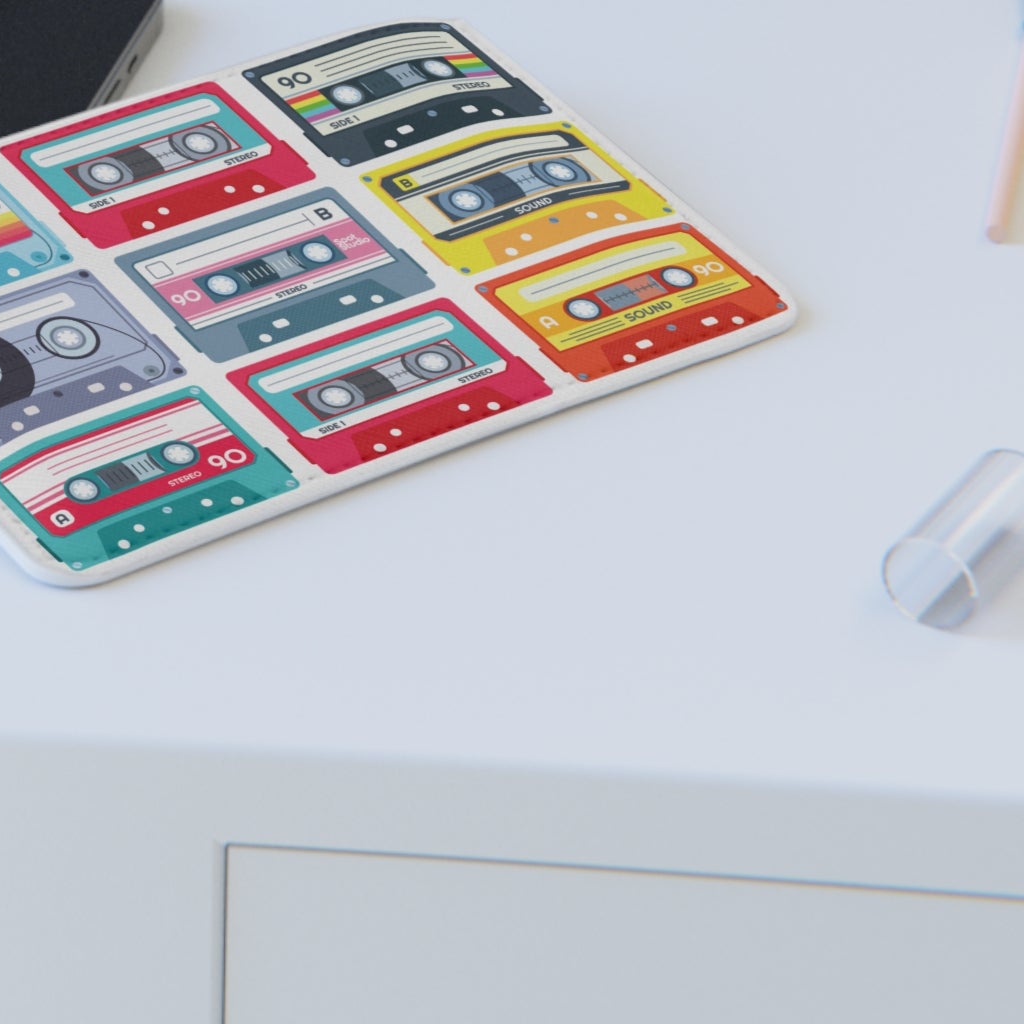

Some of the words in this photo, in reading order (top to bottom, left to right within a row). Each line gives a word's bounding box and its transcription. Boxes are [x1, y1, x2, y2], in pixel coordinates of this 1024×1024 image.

[277, 71, 312, 89] 90
[452, 81, 491, 91] STEREO
[330, 117, 354, 130] SIDE
[224, 151, 258, 166] STEREO
[399, 178, 413, 189] B
[89, 199, 110, 210] SIDE
[514, 197, 553, 215] SOUND
[313, 207, 333, 221] B
[692, 261, 725, 276] 90
[171, 289, 201, 306] 90
[275, 283, 307, 299] STEREO
[624, 300, 673, 322] SOUND
[539, 315, 560, 329] A
[458, 367, 494, 384] STEREO
[318, 423, 340, 435] SIDE
[208, 449, 247, 470] 90
[168, 471, 203, 487] STEREO
[55, 514, 70, 525] A
